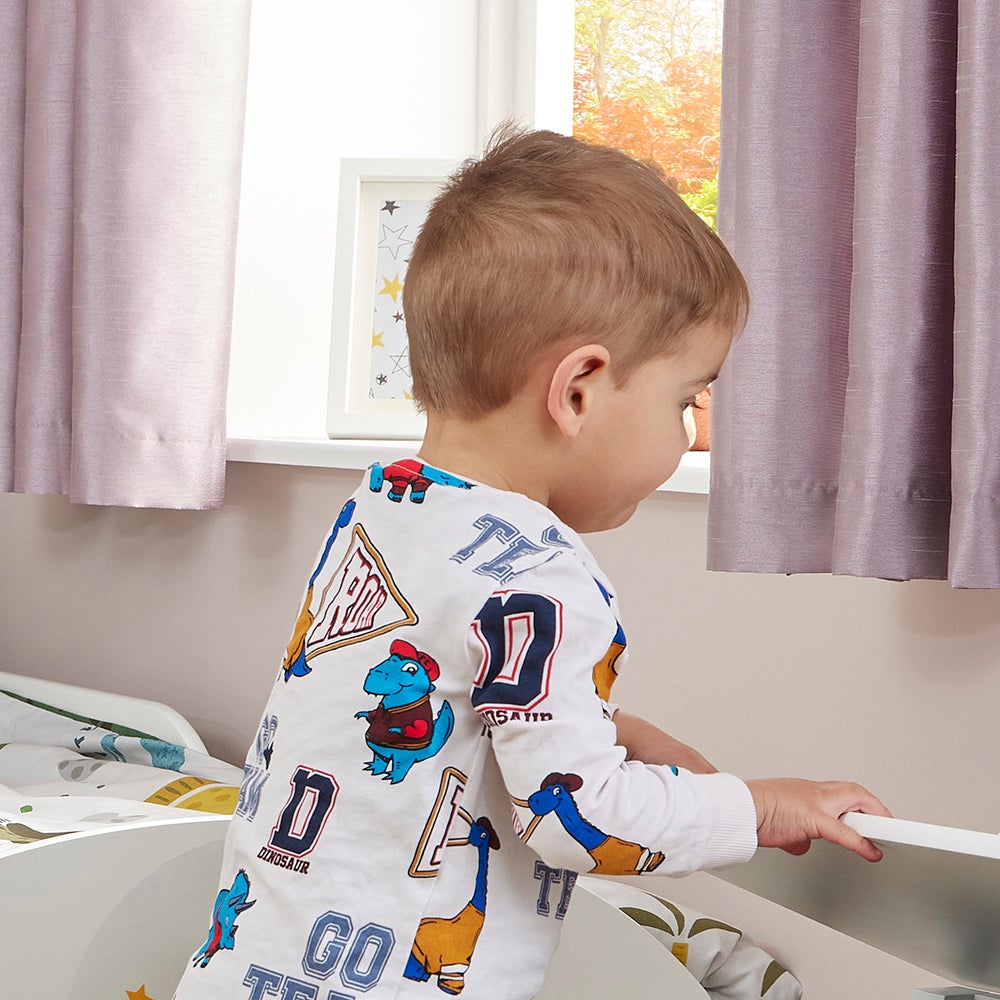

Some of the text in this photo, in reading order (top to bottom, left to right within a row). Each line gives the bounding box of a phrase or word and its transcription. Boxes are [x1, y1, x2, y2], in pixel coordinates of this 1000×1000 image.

[470, 588, 564, 713] D
[267, 764, 341, 858] D
[256, 846, 311, 875] DINOSAUR
[302, 910, 396, 993] GO
